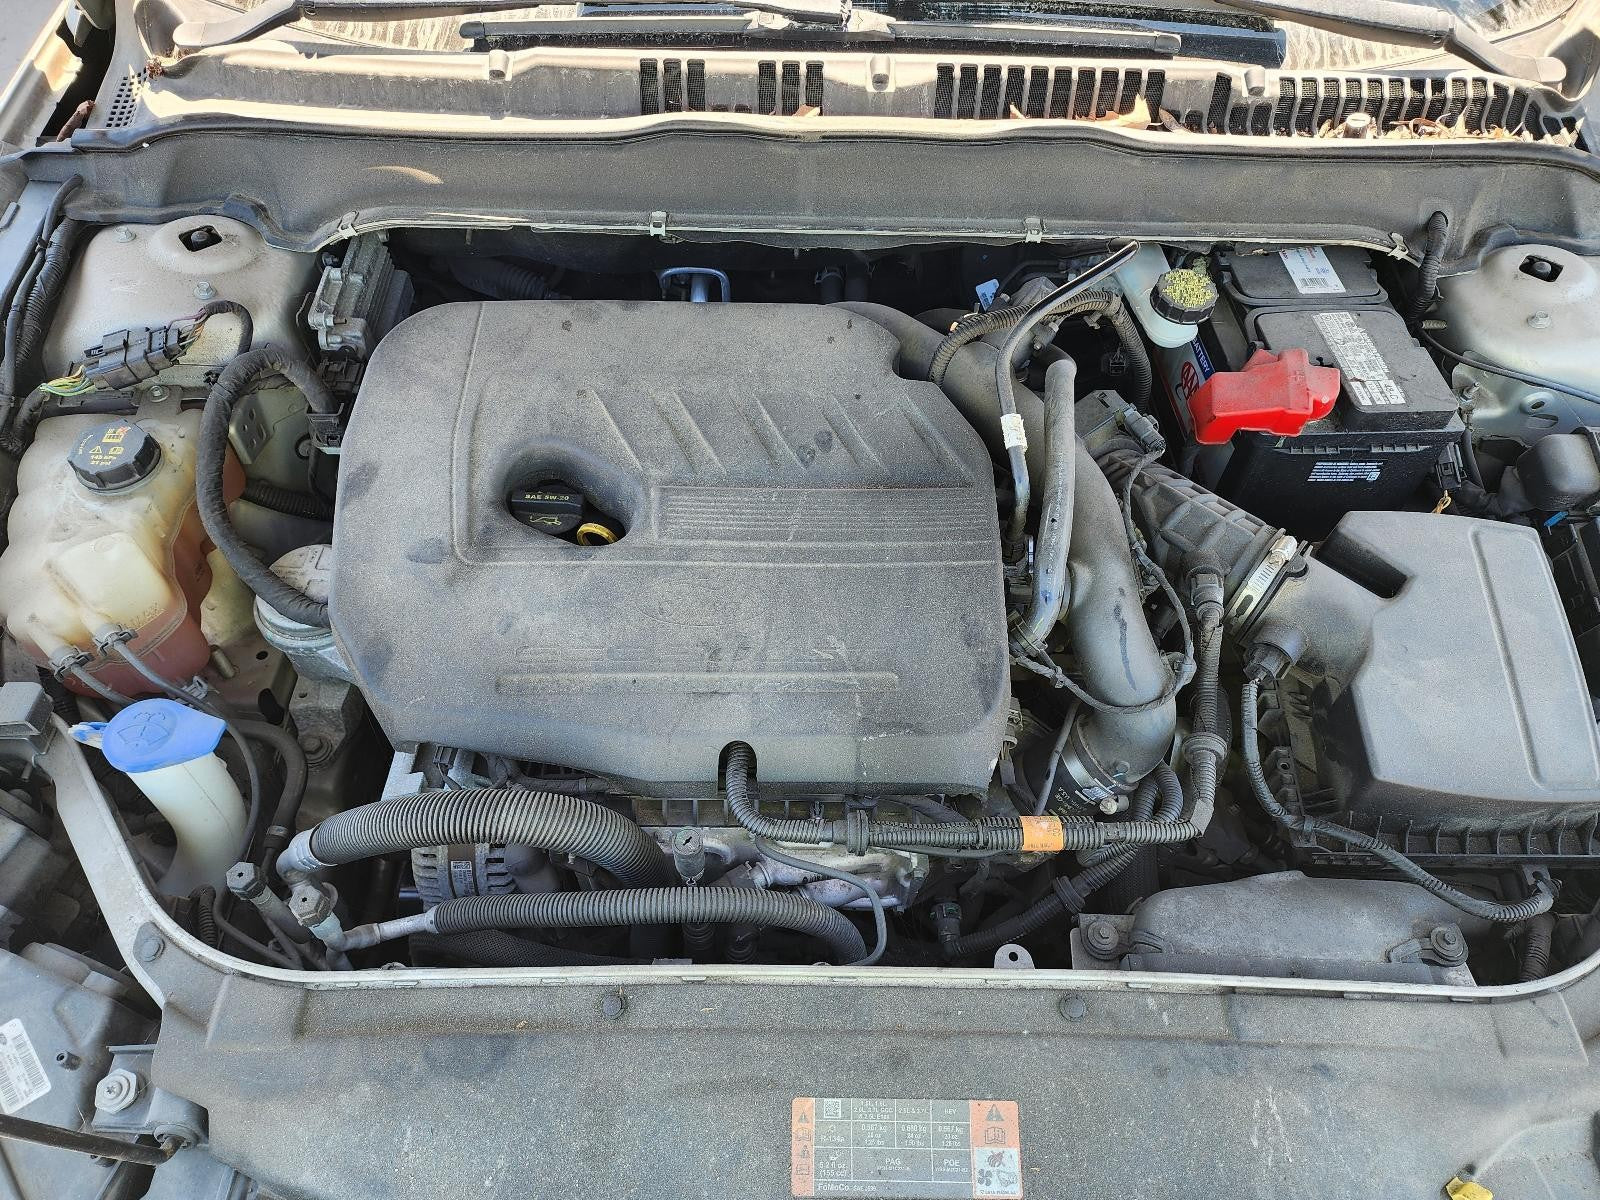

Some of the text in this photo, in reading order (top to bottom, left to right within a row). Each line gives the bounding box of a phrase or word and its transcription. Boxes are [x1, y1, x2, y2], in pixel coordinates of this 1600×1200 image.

[1192, 337, 1210, 373] BATTERY
[944, 1159, 960, 1167] POE
[818, 1183, 850, 1191] FoMoCo
